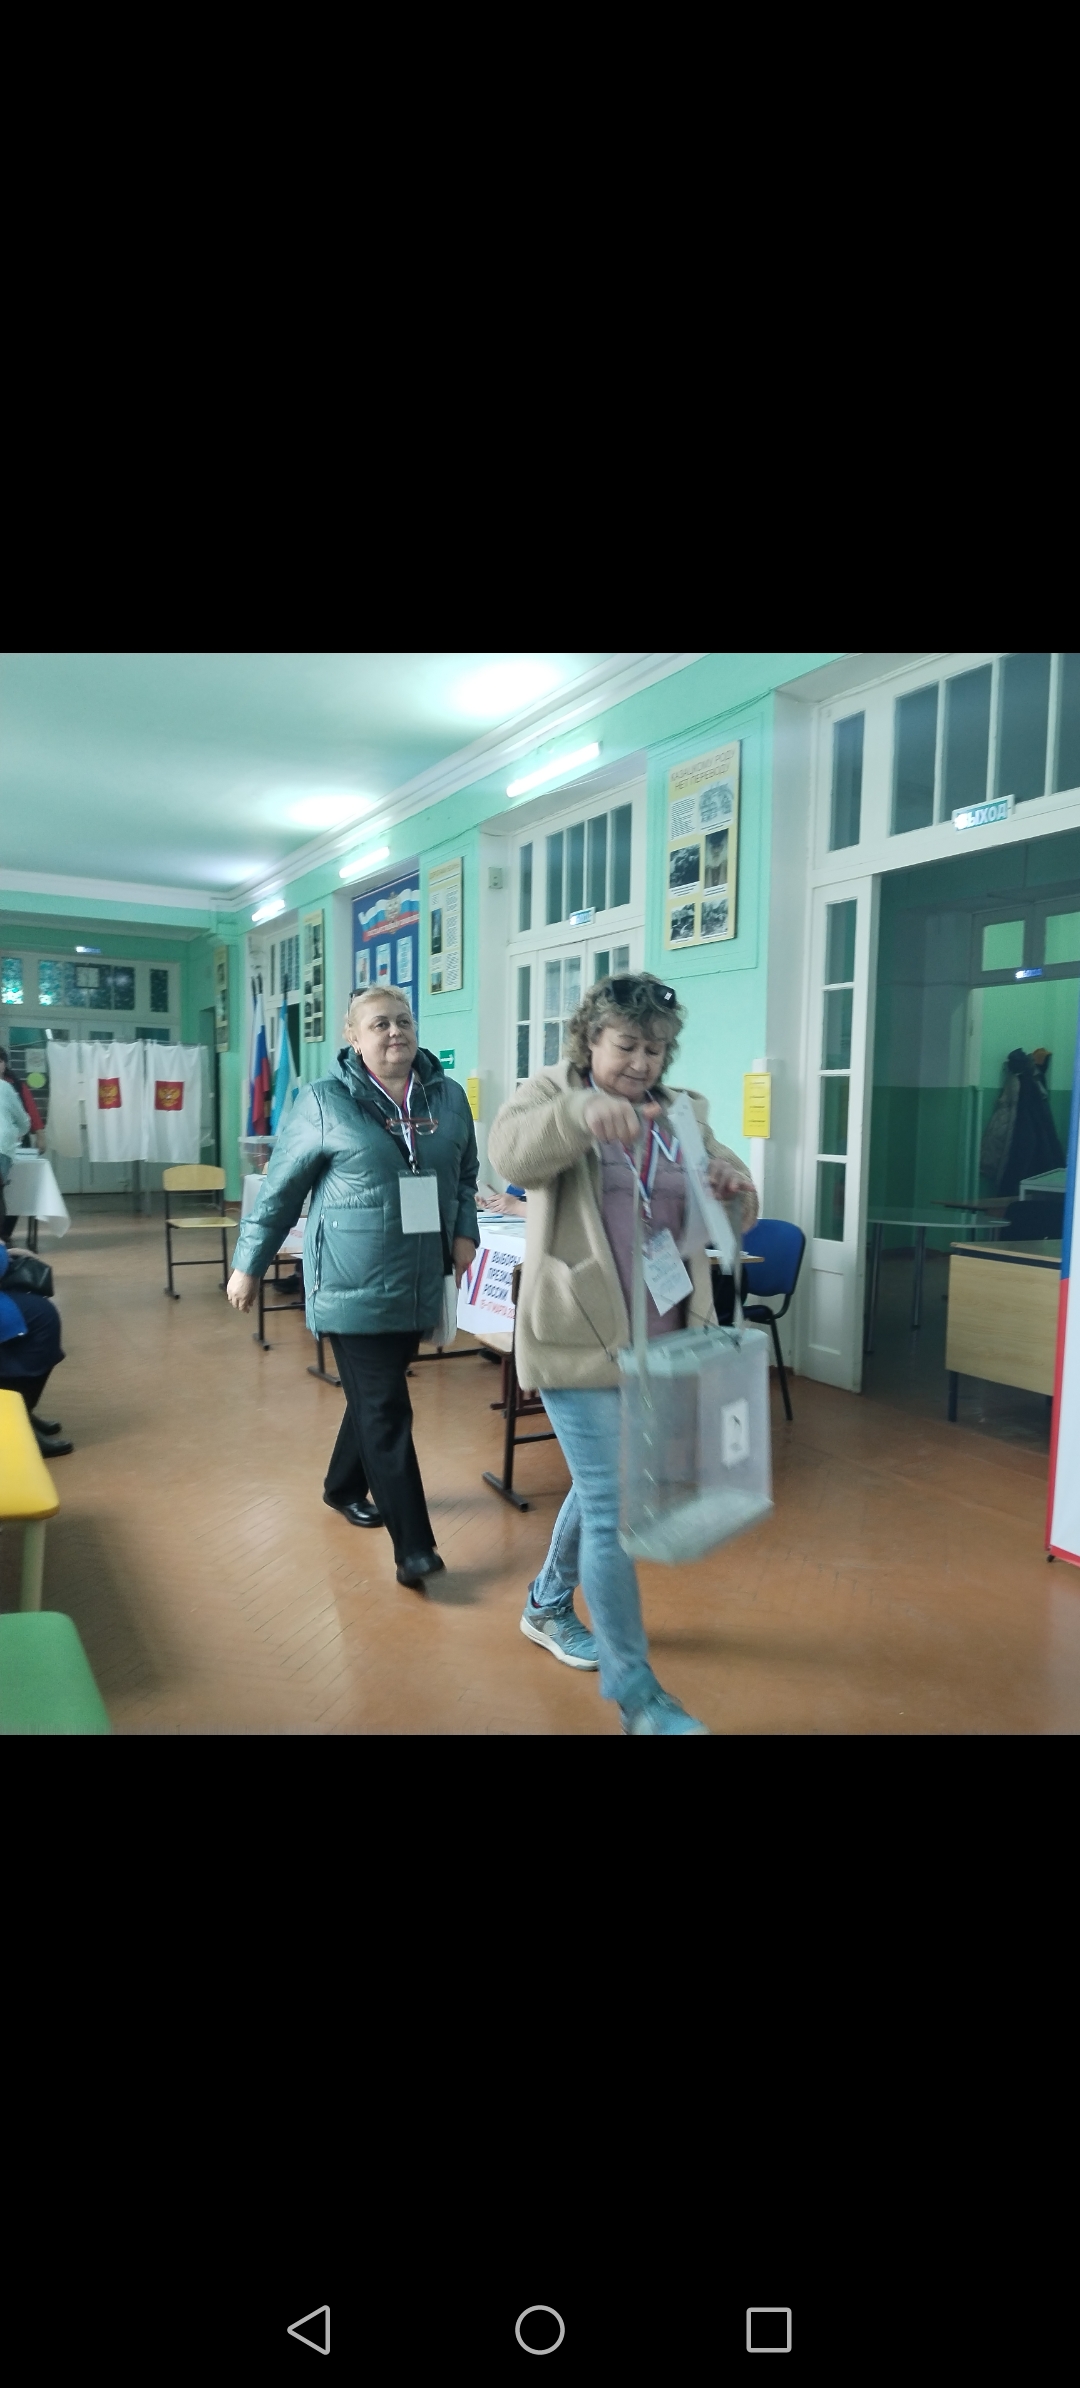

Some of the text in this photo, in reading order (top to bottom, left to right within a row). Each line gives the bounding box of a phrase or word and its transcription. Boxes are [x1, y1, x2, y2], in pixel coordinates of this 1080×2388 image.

[671, 749, 734, 781] КАЗАЦКОМУ РОДУ
[675, 763, 730, 791] НЕТ ПЕРЕВОДУ
[956, 803, 1007, 829] ЫХОД
[487, 1267, 512, 1285] ПРЕЗИД
[482, 1283, 508, 1301] РОССИИ
